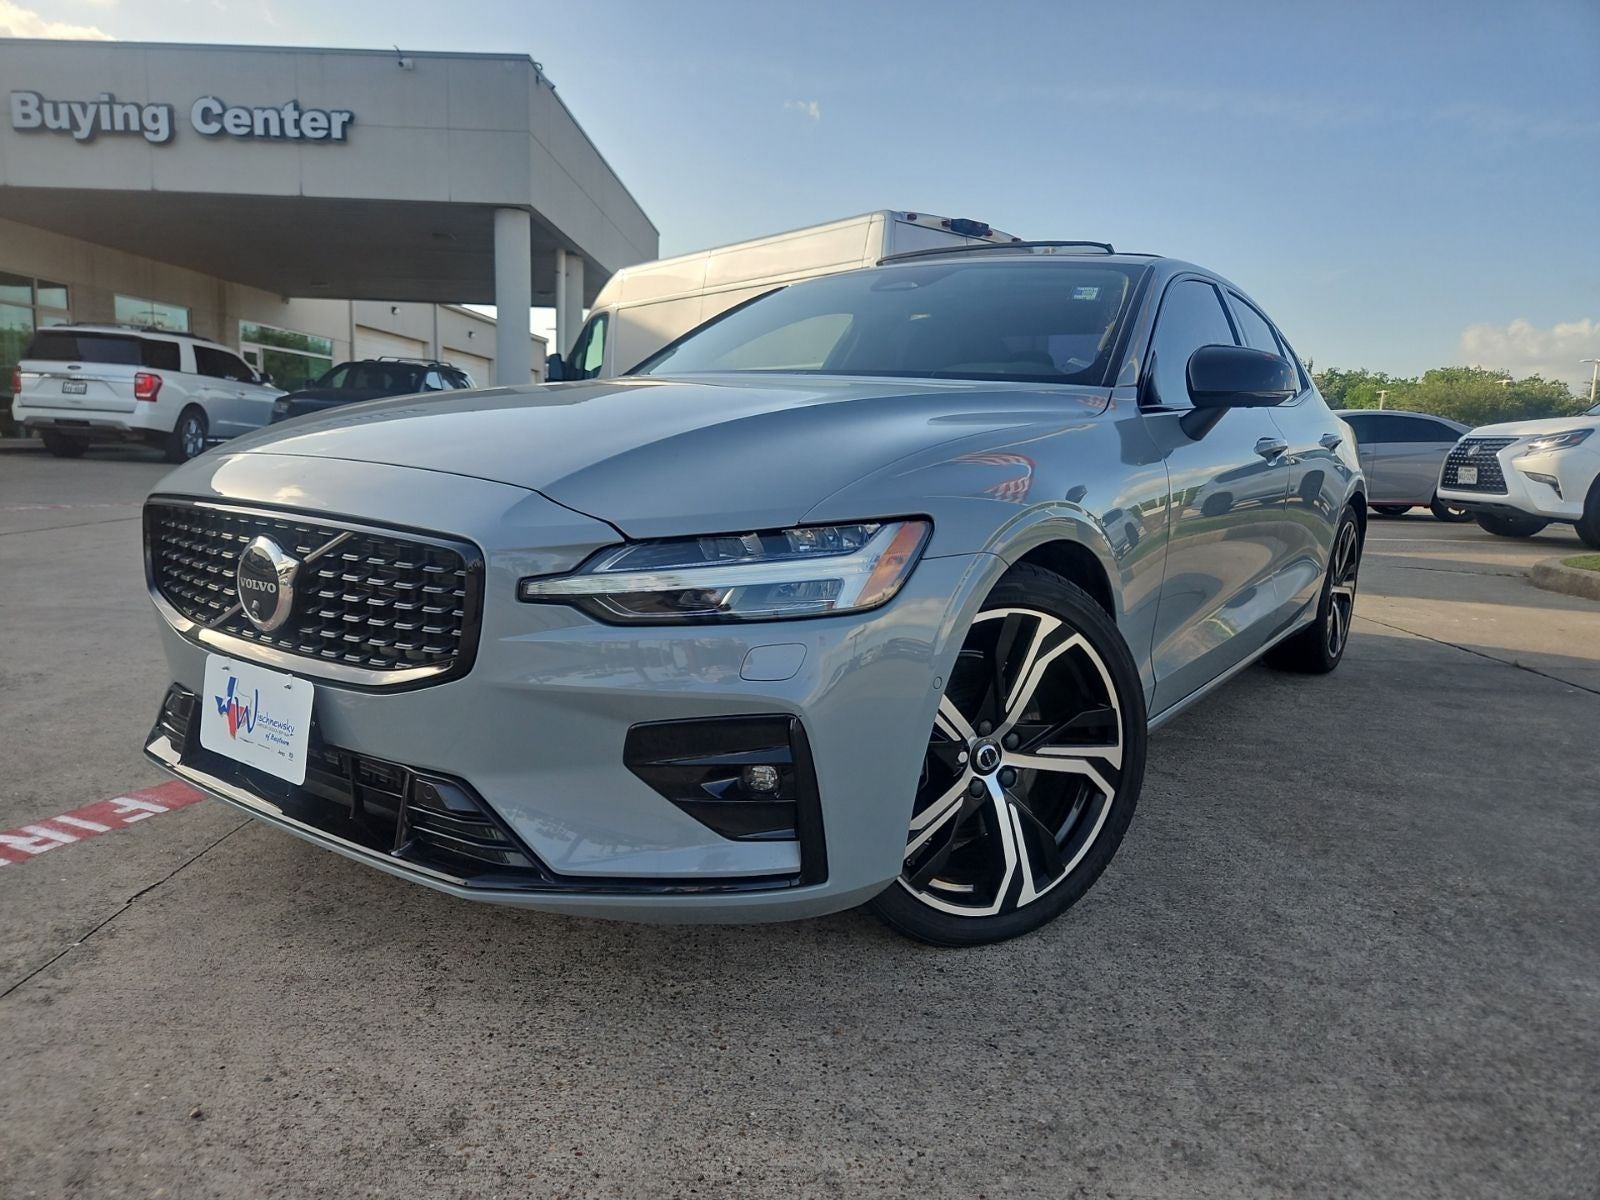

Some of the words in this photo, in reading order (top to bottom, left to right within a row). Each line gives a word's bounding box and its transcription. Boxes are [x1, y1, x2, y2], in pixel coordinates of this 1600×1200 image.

[10, 90, 174, 144] Buying
[190, 96, 354, 142] Center
[240, 577, 277, 593] VOLVO
[0, 797, 170, 867] FIR
